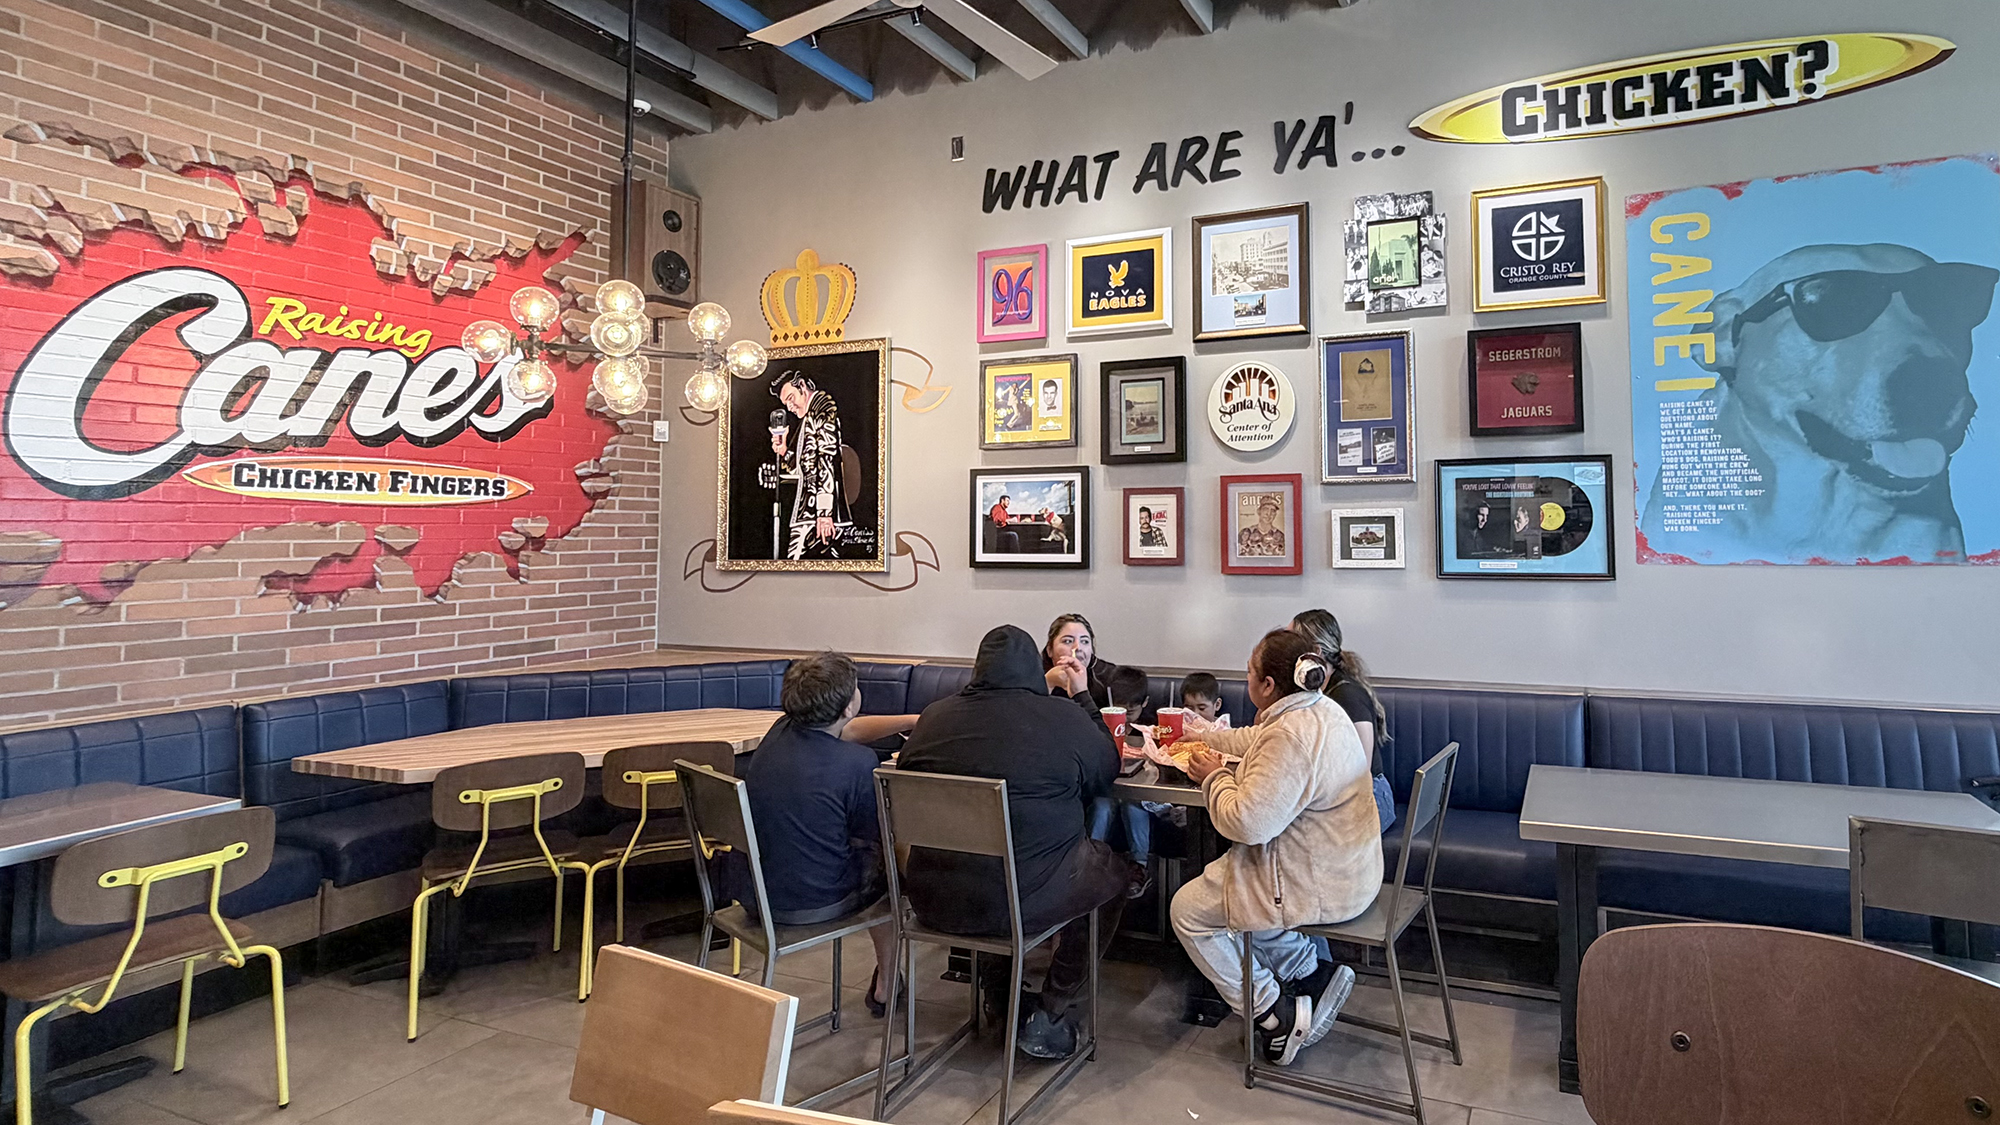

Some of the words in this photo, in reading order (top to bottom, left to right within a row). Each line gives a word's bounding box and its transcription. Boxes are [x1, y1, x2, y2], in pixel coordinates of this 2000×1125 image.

[1501, 39, 1834, 138] CHICKEN?
[982, 150, 1119, 214] WHAT
[1133, 130, 1244, 195] ARE
[1500, 264, 1545, 278] CRISTO
[1553, 261, 1576, 274] REY
[1508, 276, 1537, 284] ORANGE
[1539, 273, 1568, 281] COUNTY
[993, 267, 1033, 324] 96
[1090, 288, 1144, 298] NOVA
[1089, 295, 1147, 311] EAGLES
[258, 296, 432, 358] Raising
[1489, 347, 1561, 362] SEGERSTROM
[1219, 398, 1253, 424] Santa
[1253, 397, 1280, 422] Ana
[1501, 405, 1553, 419] JAGUARS
[1227, 423, 1260, 432] Center
[1261, 421, 1273, 432] of
[1227, 433, 1274, 442] Attention
[232, 462, 377, 493] CHICKEN
[388, 470, 506, 498] FINGERS
[1242, 492, 1281, 509] angs
